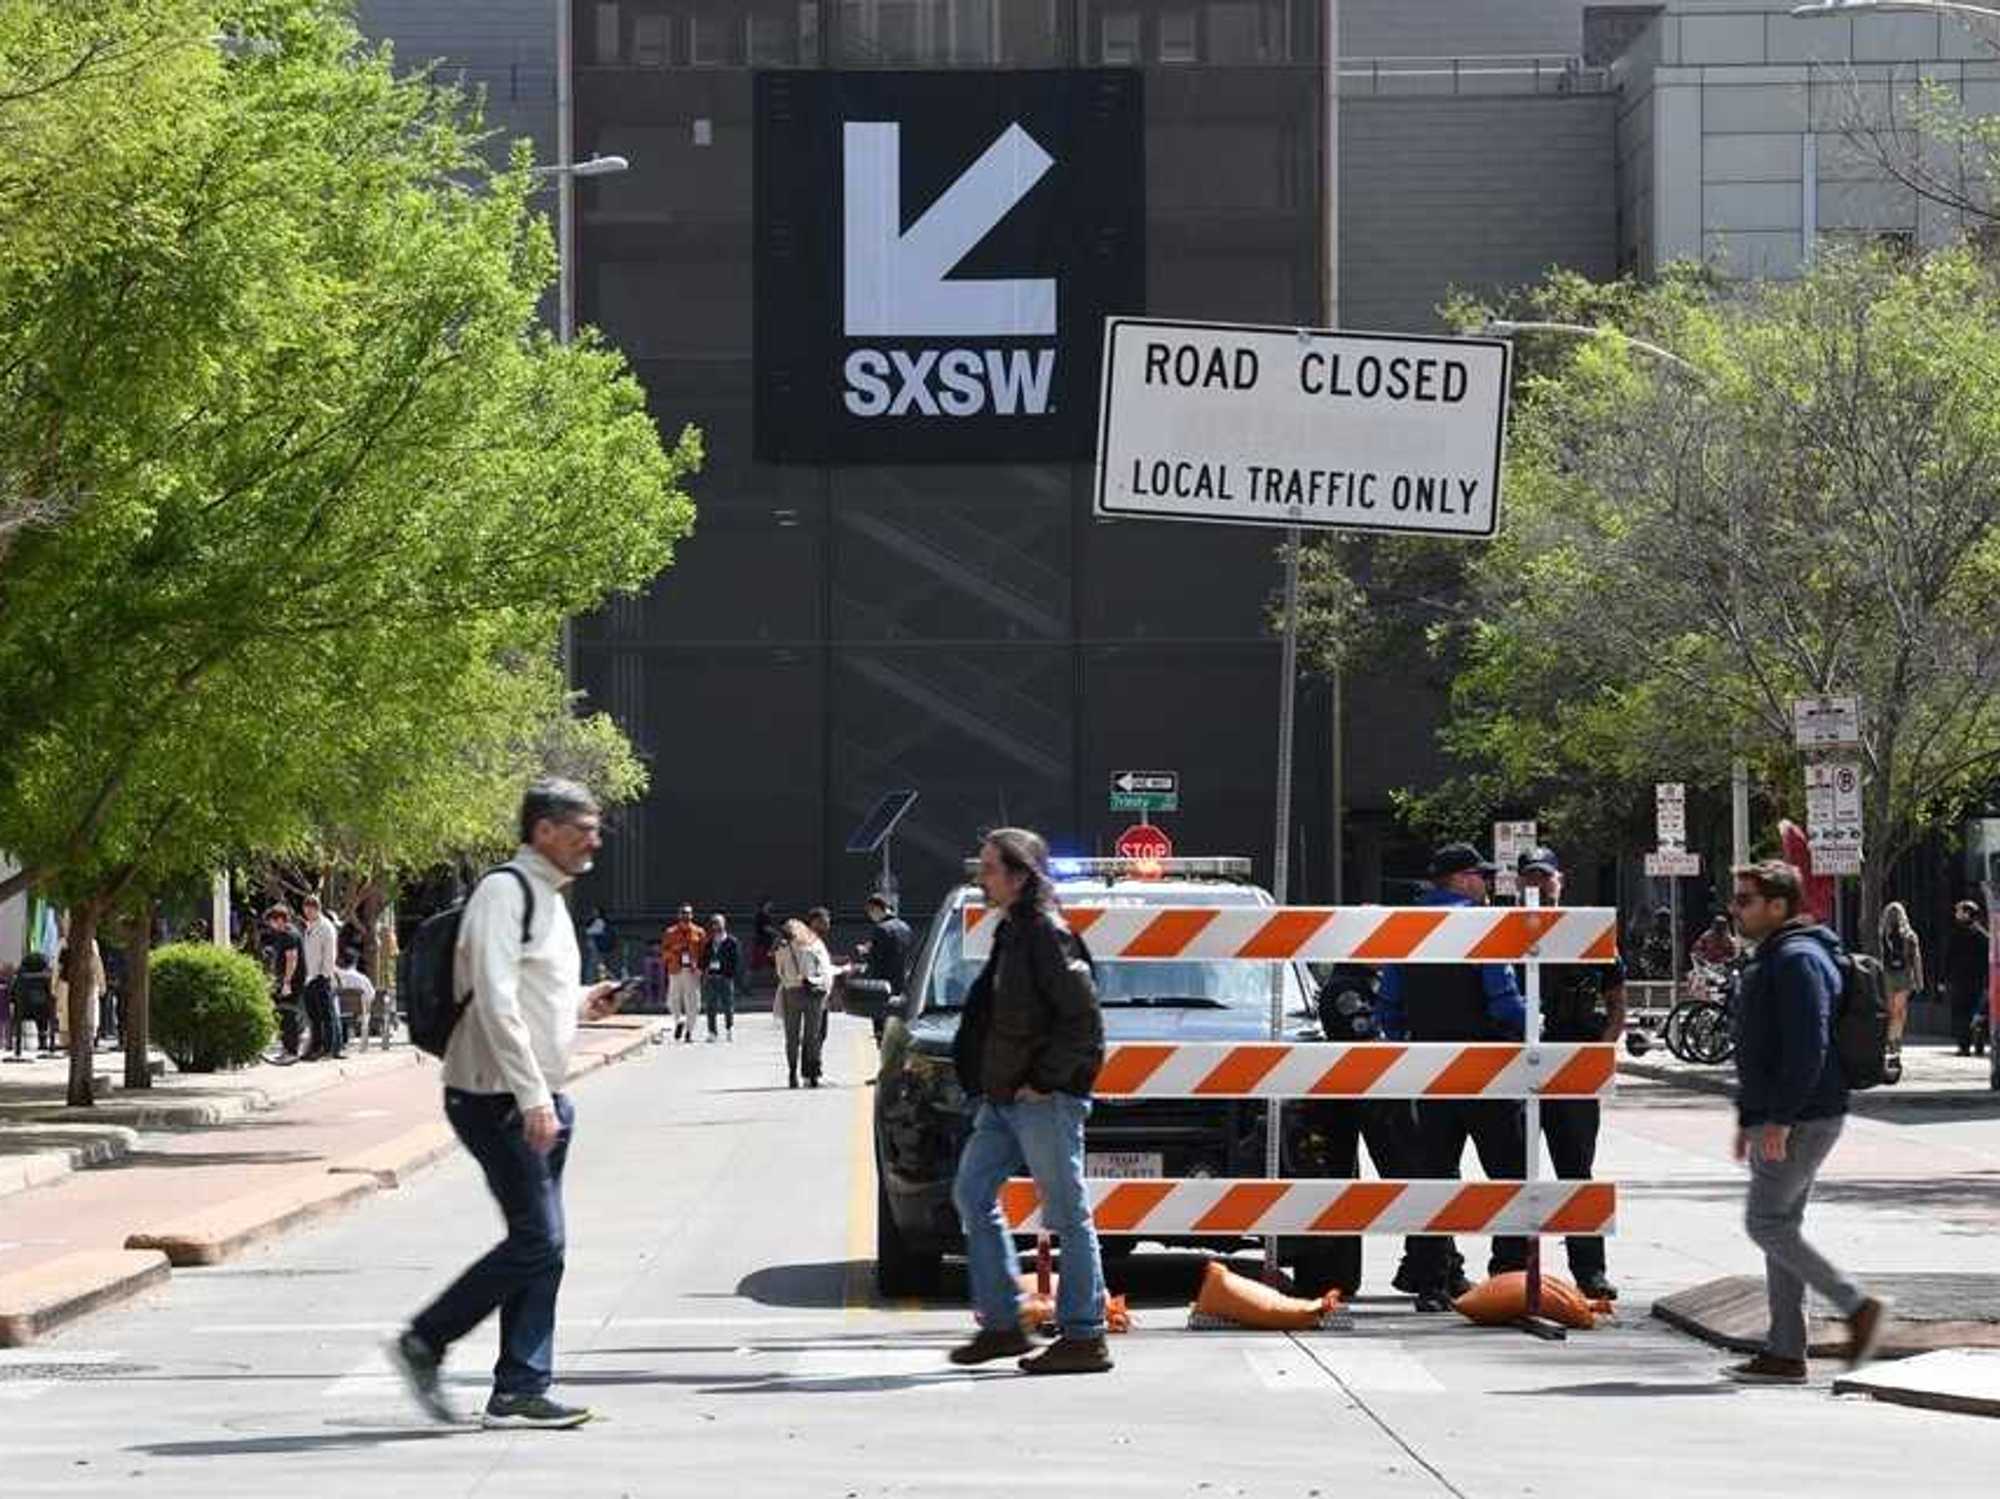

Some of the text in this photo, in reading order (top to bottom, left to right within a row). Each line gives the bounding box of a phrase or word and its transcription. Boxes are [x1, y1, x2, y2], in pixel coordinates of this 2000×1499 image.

[845, 350, 1054, 415] SXSW
[1145, 343, 1468, 402] ROAD CLOSED
[1133, 459, 1478, 514] LOCAL TRAFFIC ONLY
[1121, 843, 1167, 858] STOP
